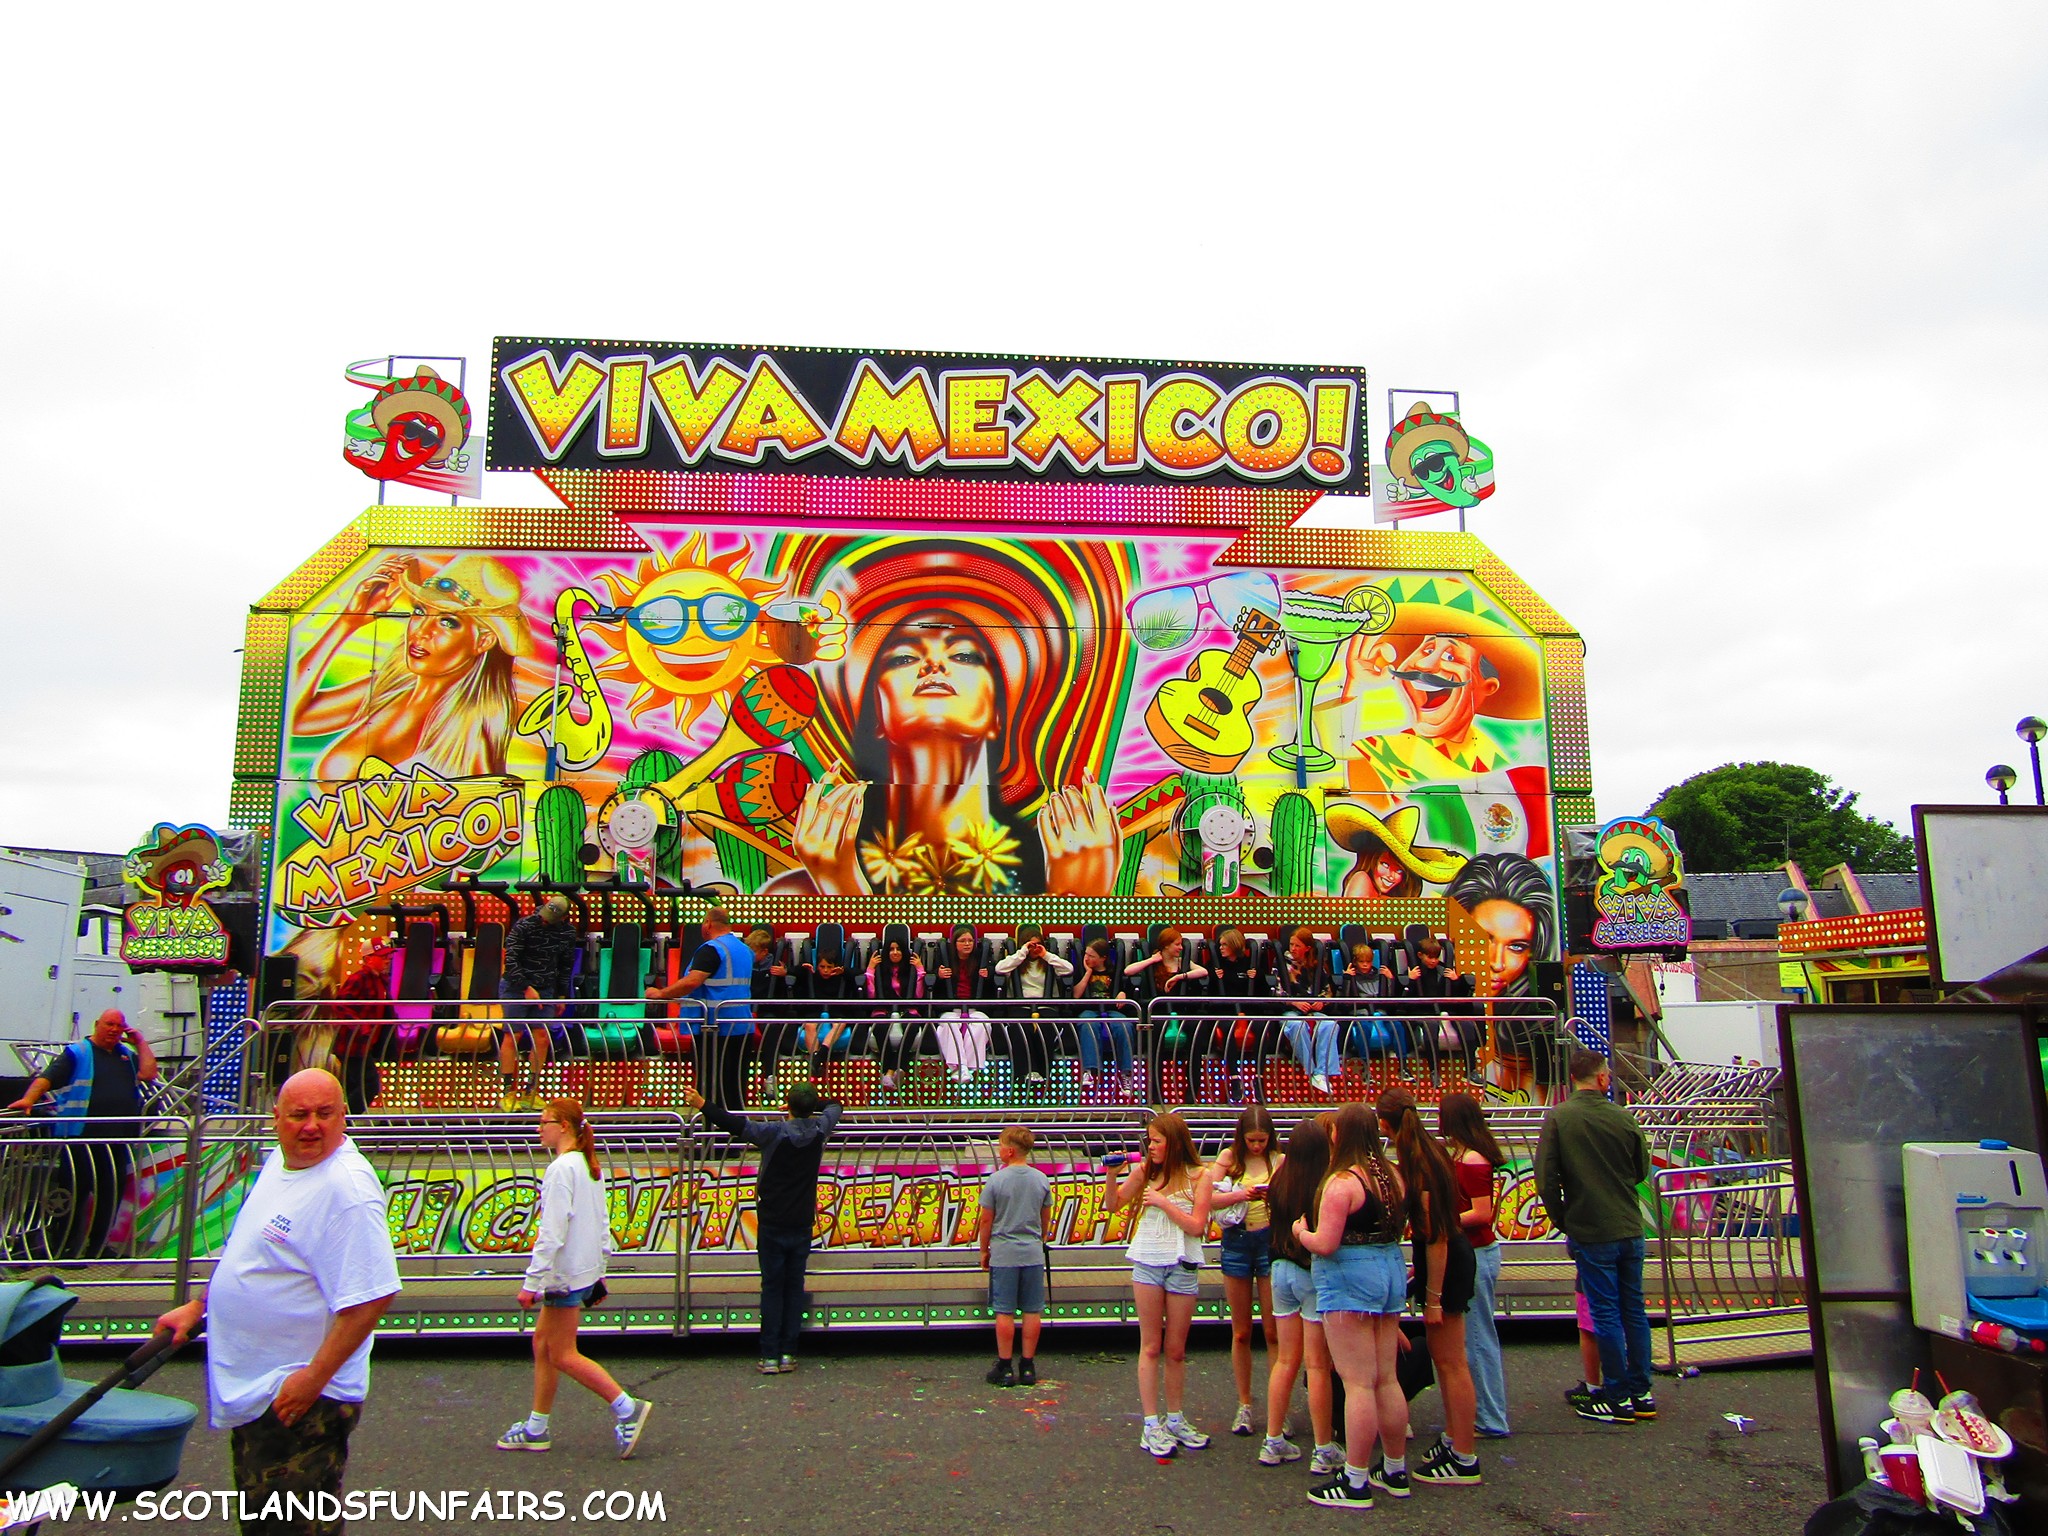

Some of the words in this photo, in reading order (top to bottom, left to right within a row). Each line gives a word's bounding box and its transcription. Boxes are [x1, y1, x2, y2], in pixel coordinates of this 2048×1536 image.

[502, 350, 829, 464] VIVA
[833, 359, 1356, 483] MEXICO!
[291, 763, 457, 847] VIVA
[286, 789, 524, 911] MEXICO!
[130, 906, 221, 937] VIVA
[1599, 892, 1680, 923] VIVA
[1595, 919, 1688, 944] MEXICO!
[125, 936, 227, 960] MEXICO!
